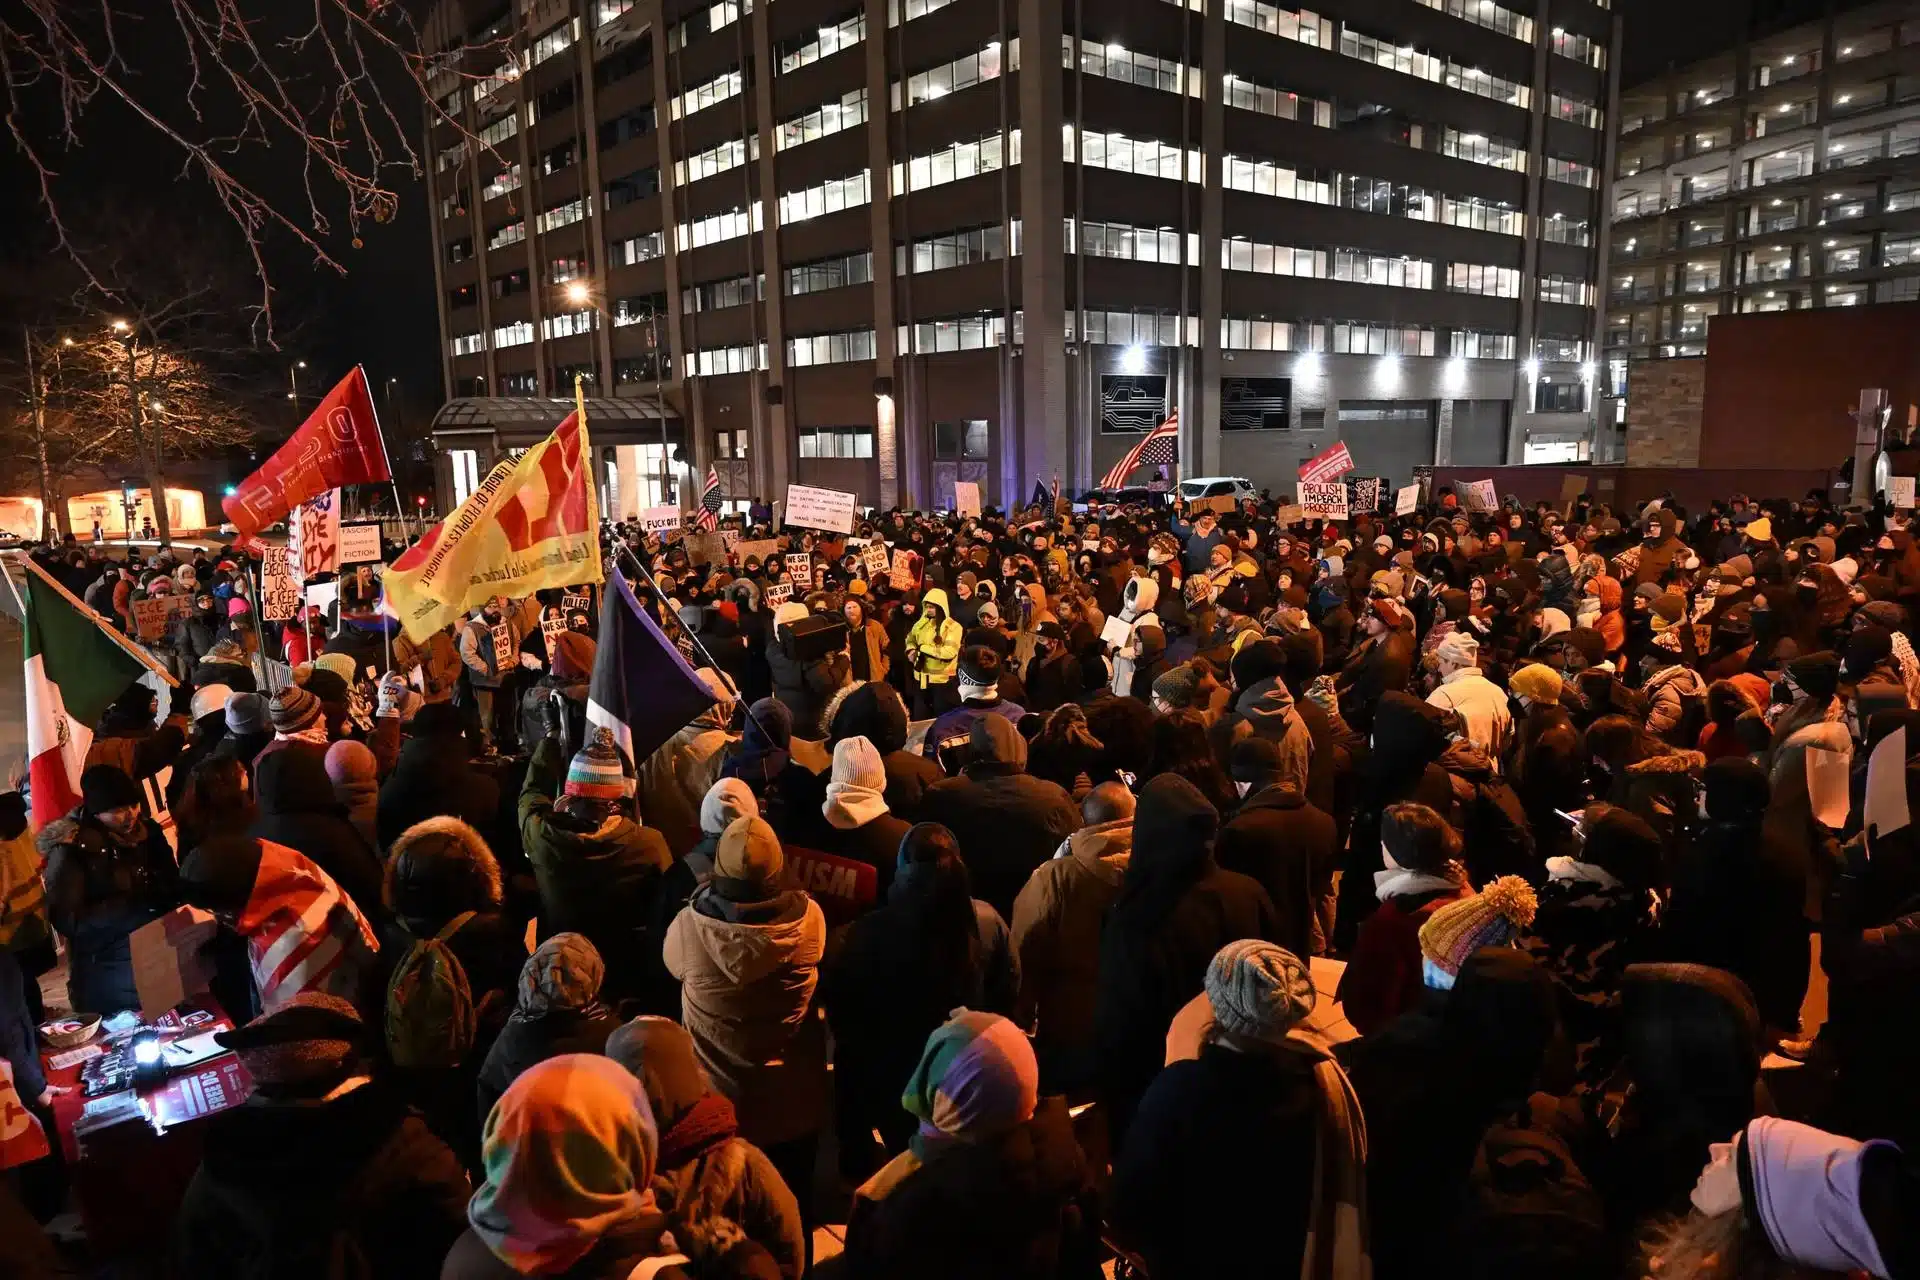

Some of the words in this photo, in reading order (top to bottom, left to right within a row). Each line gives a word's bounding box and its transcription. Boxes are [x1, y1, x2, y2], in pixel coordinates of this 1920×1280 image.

[481, 464, 512, 496] LEAGUE
[1303, 482, 1342, 495] ABOLISH
[474, 493, 489, 508] OF
[1304, 494, 1343, 504] IMPEACH
[1304, 503, 1347, 514] PROSECUTE
[450, 503, 481, 543] PEOPLES
[646, 519, 666, 530] FUCK
[666, 517, 677, 526] OFF
[342, 526, 374, 535] FASCISM
[265, 547, 278, 562] THE
[343, 549, 376, 559] FICTION
[872, 545, 883, 553] SAY
[786, 555, 796, 563] WE
[797, 554, 809, 562] SAY
[865, 552, 886, 564] NO
[264, 560, 292, 577] EXECUT
[420, 542, 453, 588] STRUGGLE
[787, 564, 809, 573] NO
[275, 575, 288, 591] US
[768, 587, 779, 597] WE
[779, 585, 791, 594] SAY
[264, 589, 276, 607] WE
[562, 597, 589, 608] KILLER
[135, 600, 165, 615] ICE
[264, 604, 279, 619] US
[542, 622, 555, 632] WE
[495, 637, 509, 649] NO
